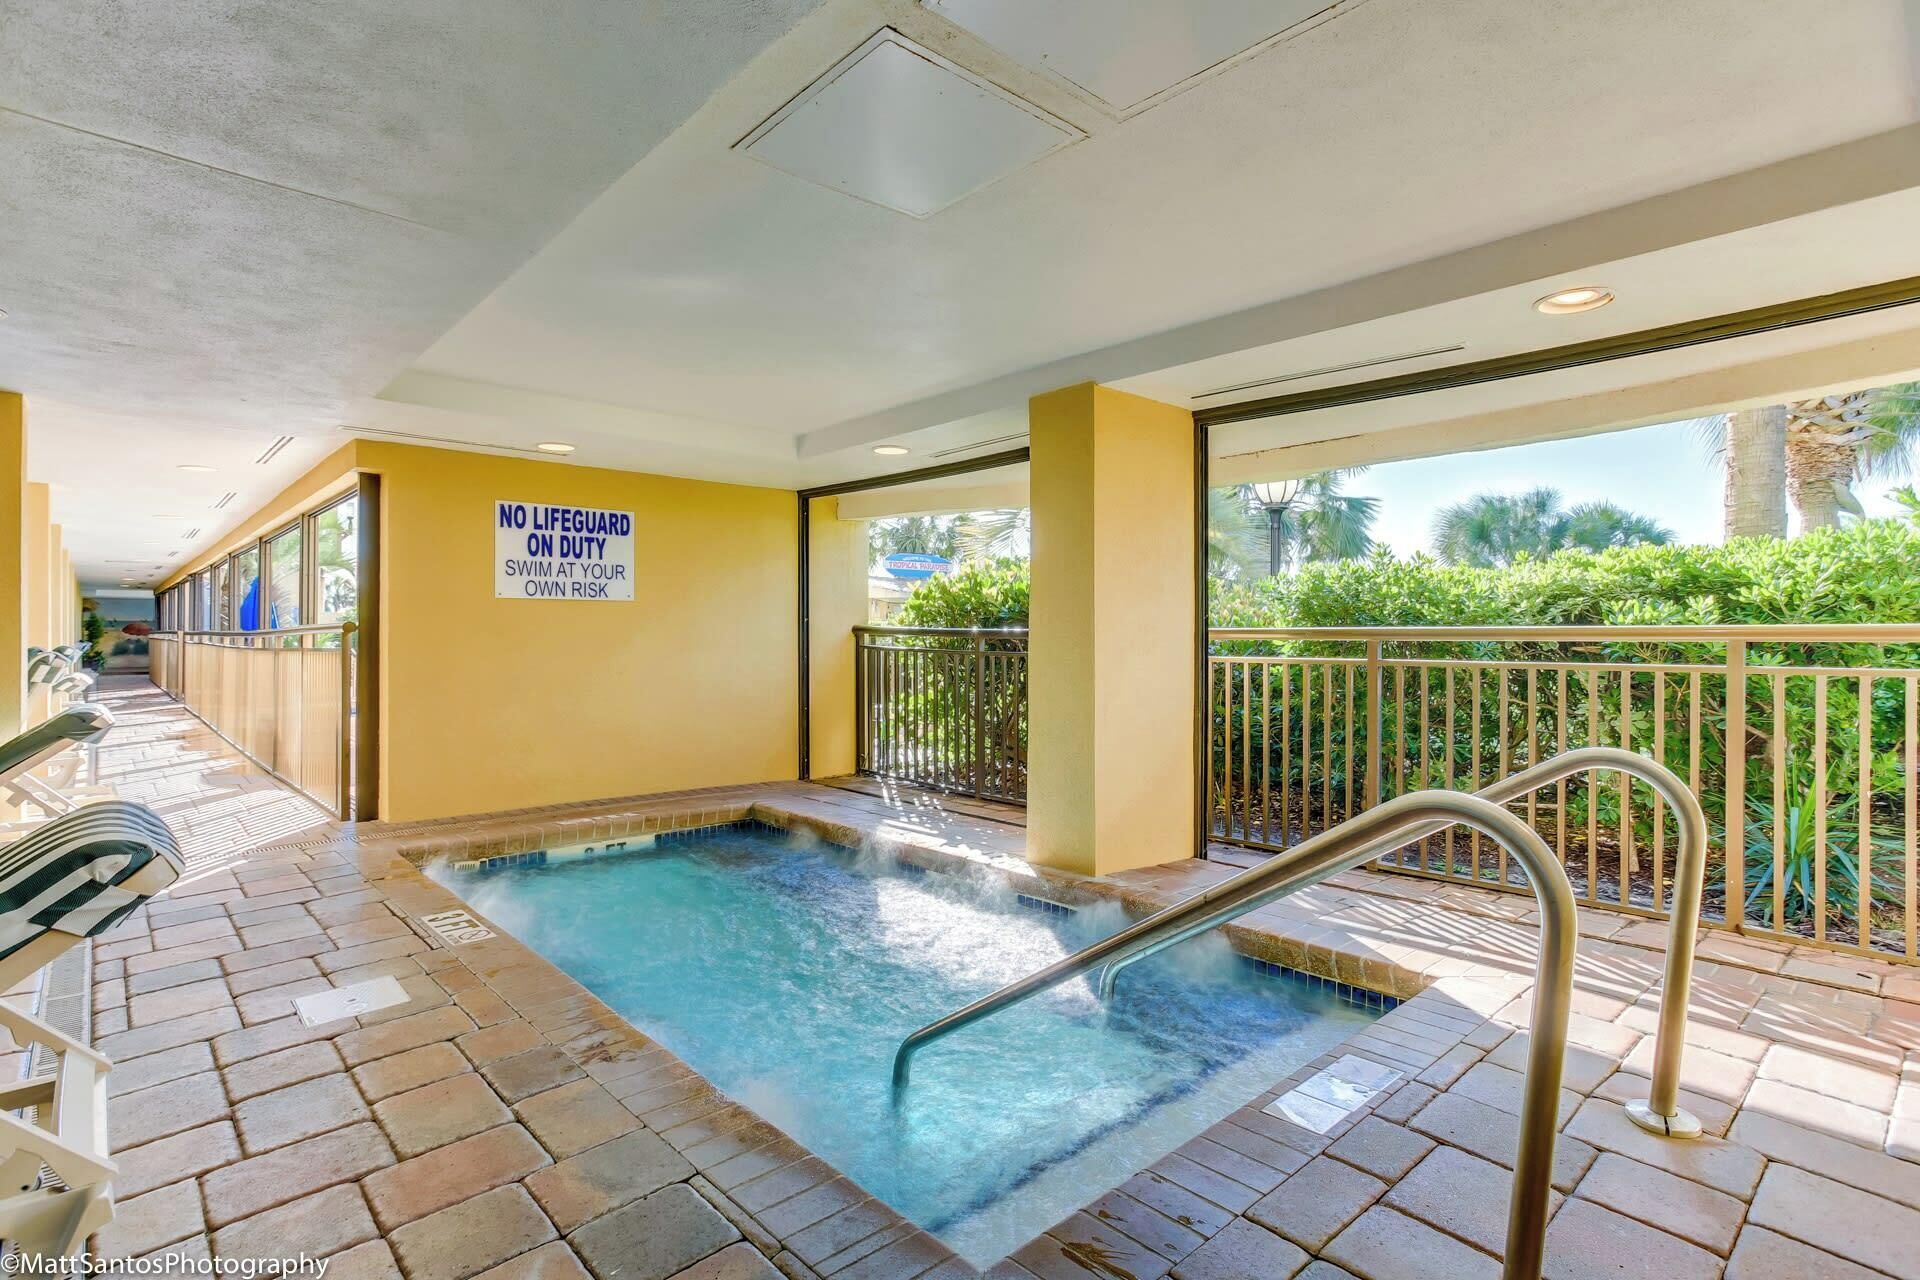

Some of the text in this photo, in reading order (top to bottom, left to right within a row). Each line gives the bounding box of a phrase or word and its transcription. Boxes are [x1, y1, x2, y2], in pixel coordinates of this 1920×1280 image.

[499, 503, 630, 536] NO LIFEGUARD
[527, 533, 606, 560] ON DUTY
[505, 559, 626, 580] SWIM AT YOUR
[889, 561, 917, 569] TROPICAL
[525, 580, 608, 598] OWN RISK
